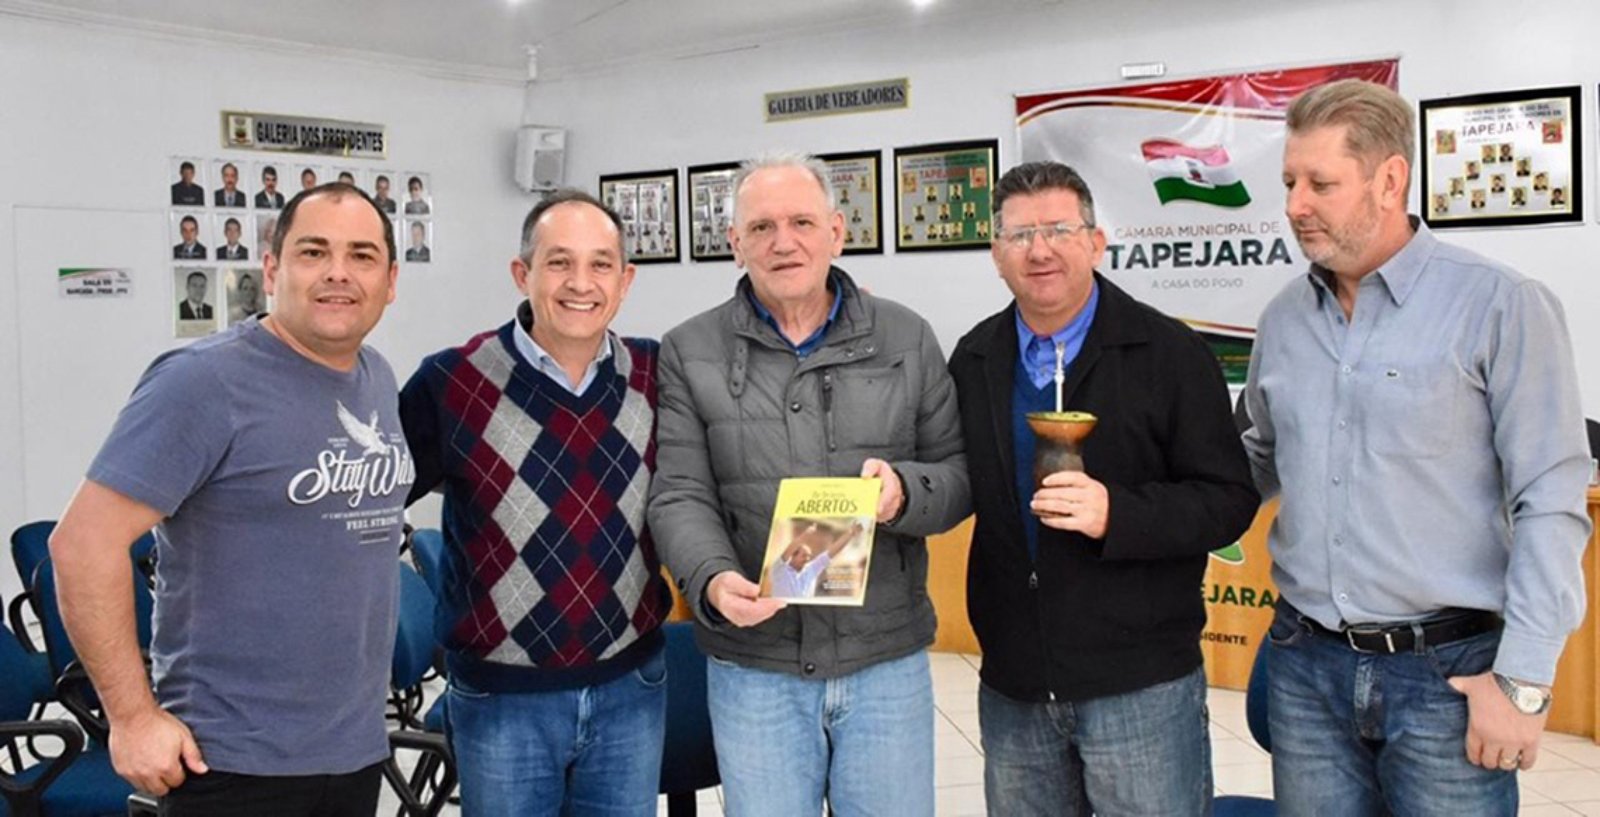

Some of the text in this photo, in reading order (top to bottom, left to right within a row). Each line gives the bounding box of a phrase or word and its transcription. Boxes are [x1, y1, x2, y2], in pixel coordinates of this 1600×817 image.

[768, 85, 905, 116] GALERIA DE VEREADORES
[256, 121, 383, 152] GALERIA DOS PRESIDENTES
[1178, 221, 1256, 238] MUNICIPAL
[1259, 220, 1281, 235] DE
[1106, 237, 1293, 271] TAPEJARA
[1151, 277, 1243, 289] A CASA DO POVO
[288, 449, 370, 508] Stay
[795, 499, 858, 514] ABERTOS
[346, 515, 399, 530] FEEL STRONG
[1202, 631, 1248, 646] IDENTE
